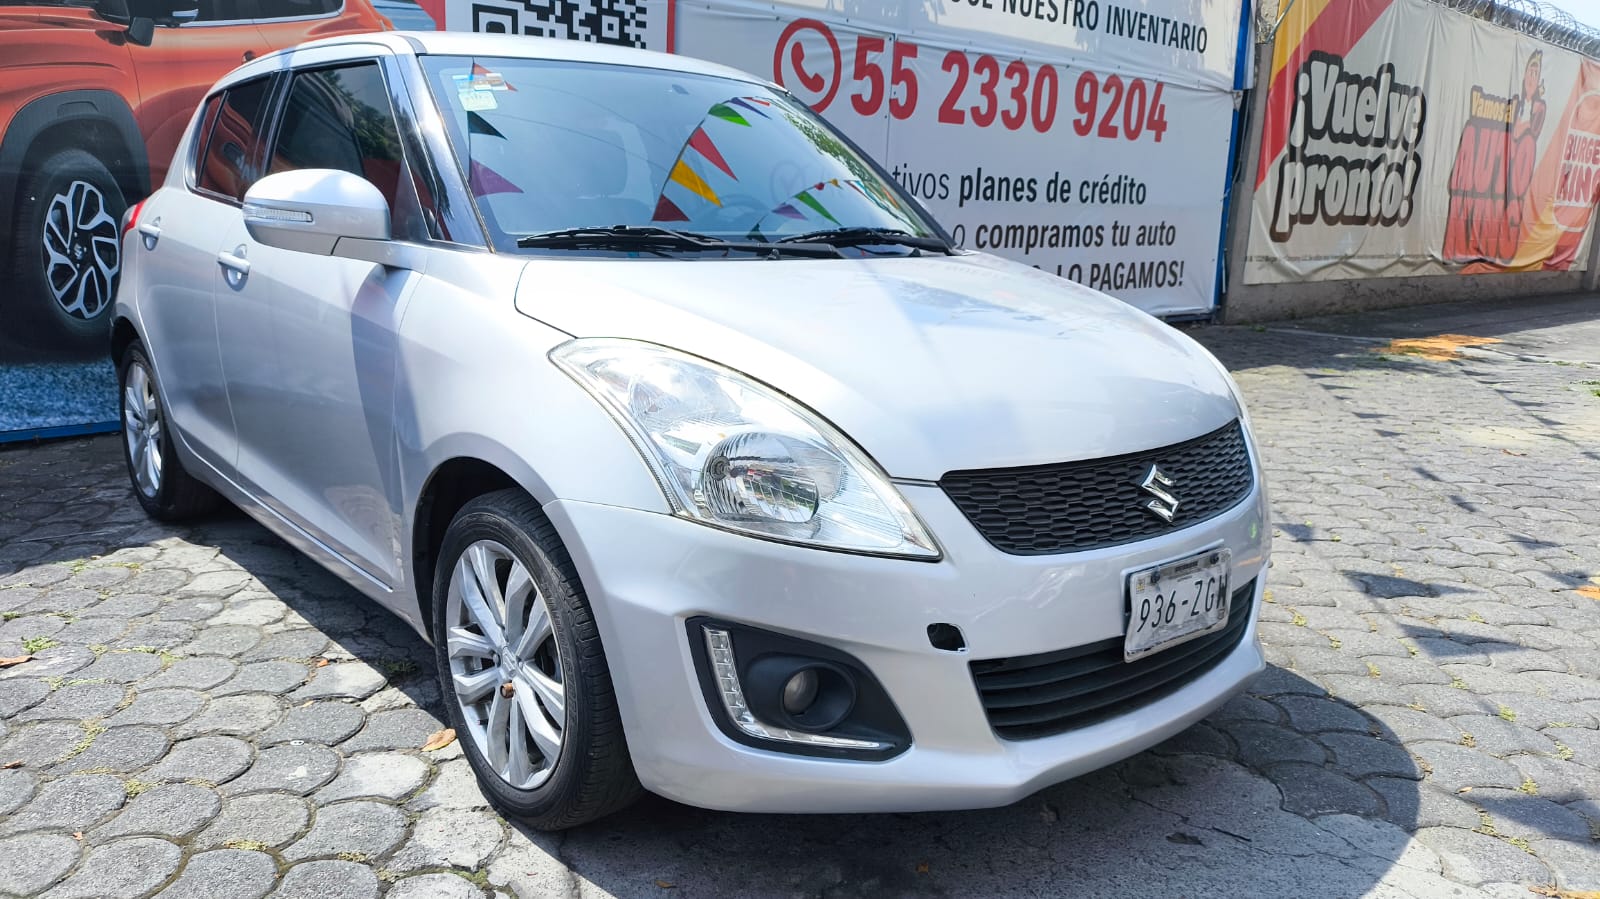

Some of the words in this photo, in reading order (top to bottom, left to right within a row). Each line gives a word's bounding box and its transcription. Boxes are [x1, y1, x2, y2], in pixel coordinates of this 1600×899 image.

[1106, 5, 1207, 54] INVENTARIO
[851, 35, 918, 120] 55
[938, 50, 1058, 133] 2330
[1073, 70, 1167, 143] 9204
[1289, 55, 1425, 149] ¡Vuelve
[959, 167, 1038, 208] planes
[1046, 172, 1071, 204] de
[1079, 174, 1147, 205] crédito
[1451, 124, 1537, 197] AUTO
[1272, 156, 1419, 238] pronto!
[976, 222, 1104, 254] compramos
[1112, 220, 1130, 247] tu
[1136, 220, 1176, 247] auto
[1090, 260, 1185, 291] PAGAMOS!
